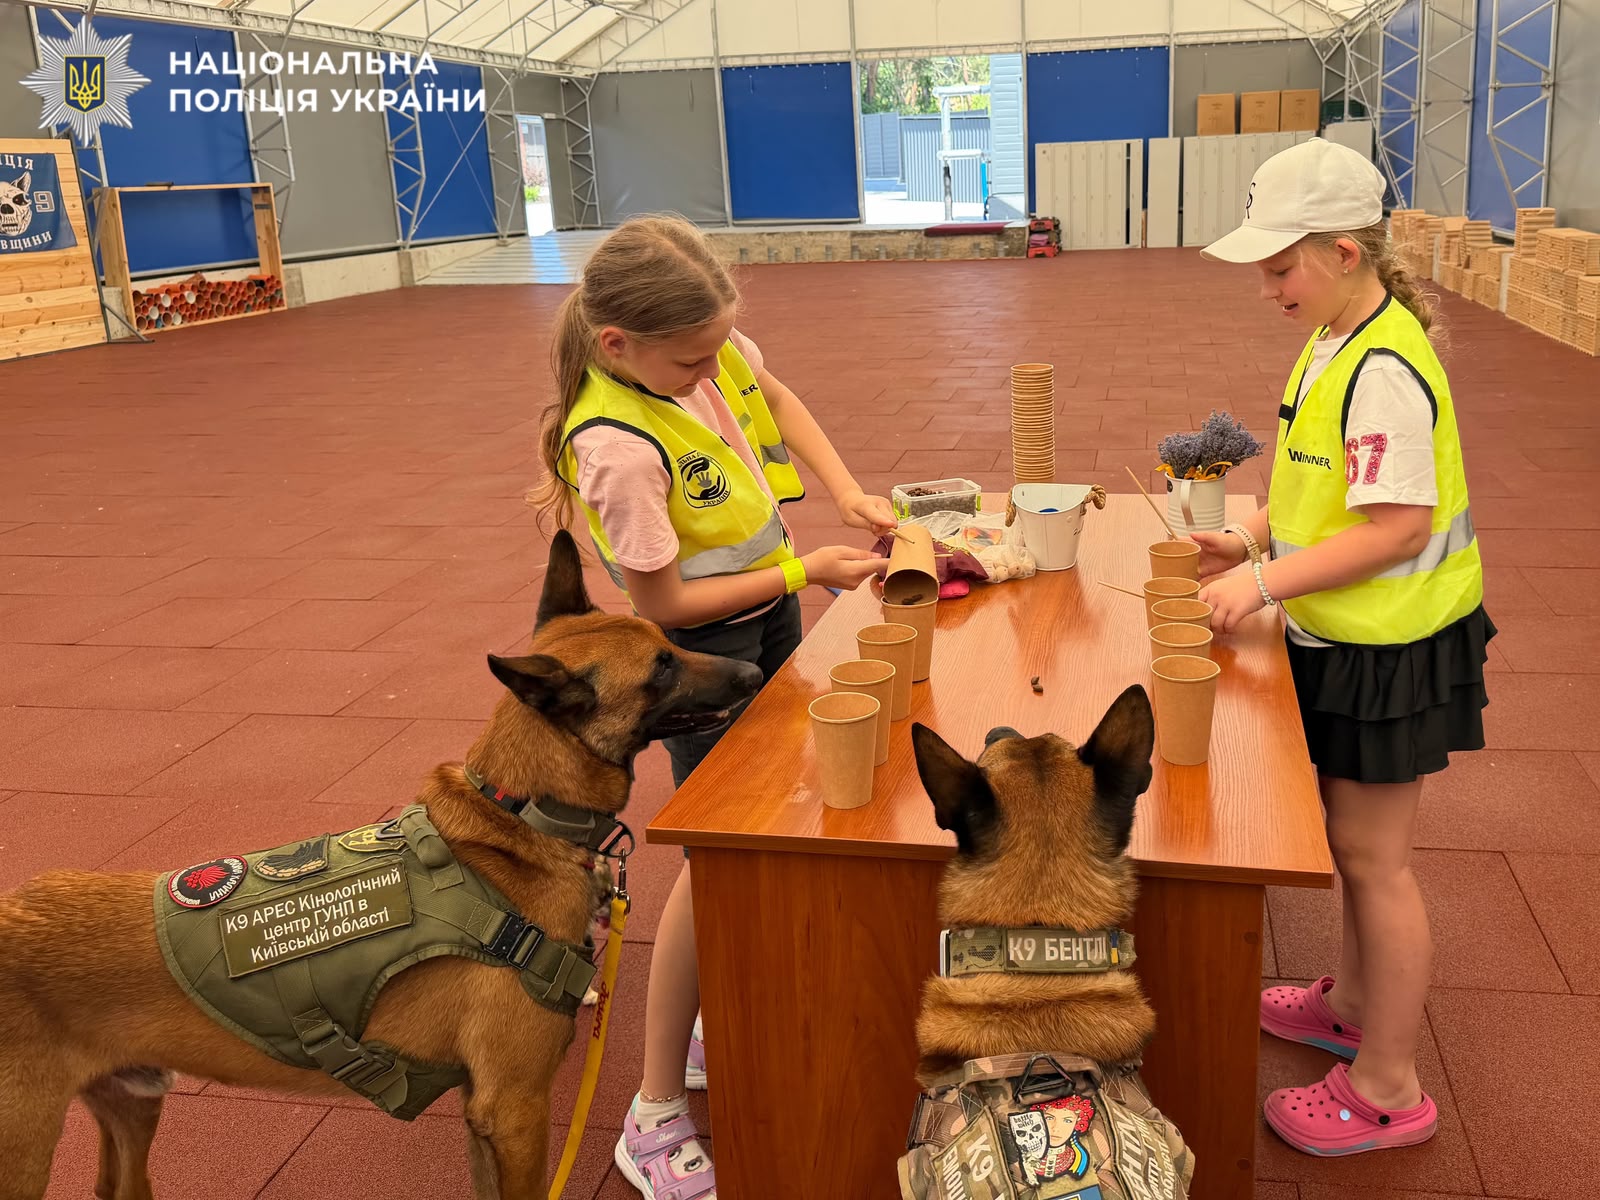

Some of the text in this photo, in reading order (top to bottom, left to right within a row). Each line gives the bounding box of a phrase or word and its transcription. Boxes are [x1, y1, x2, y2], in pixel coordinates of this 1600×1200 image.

[0, 154, 34, 171] ЦІЯ
[1287, 447, 1332, 470] WINNER
[252, 900, 296, 926] АРЕС
[298, 867, 401, 912] Кінологічний
[250, 906, 390, 964] Київській області
[263, 898, 369, 941] центр ГУНП в
